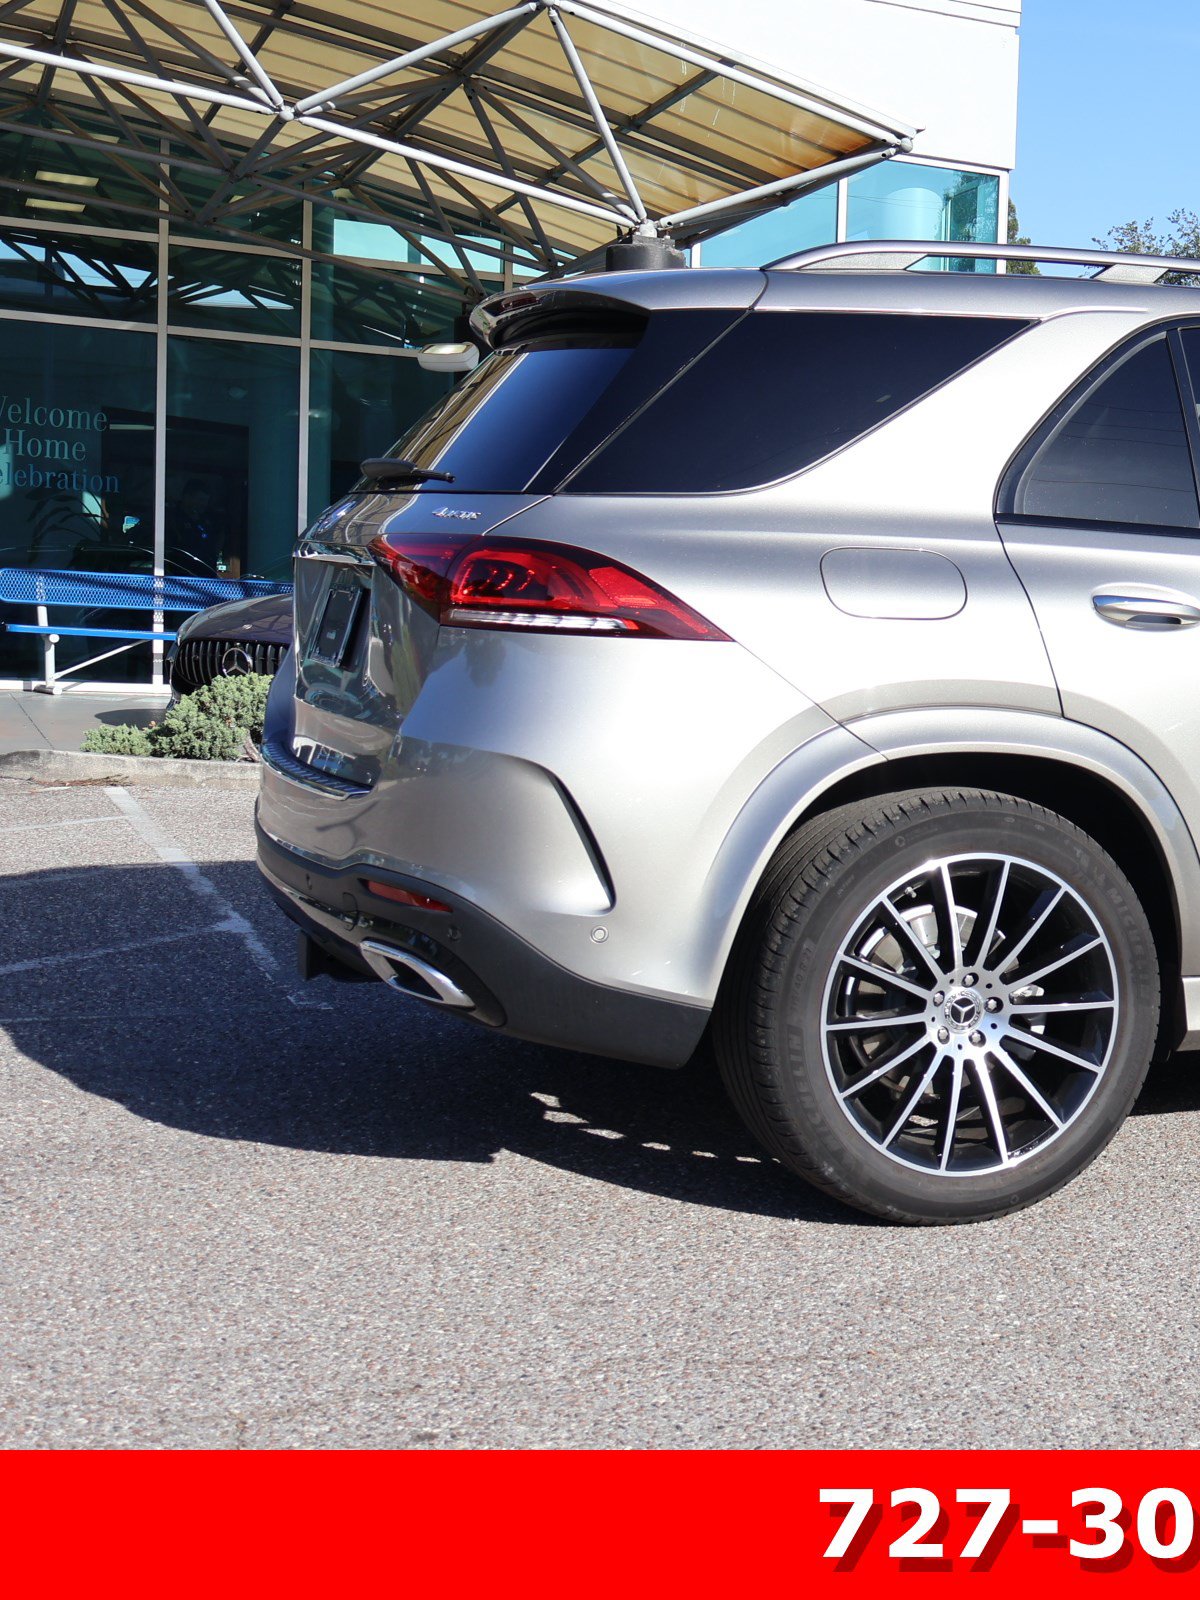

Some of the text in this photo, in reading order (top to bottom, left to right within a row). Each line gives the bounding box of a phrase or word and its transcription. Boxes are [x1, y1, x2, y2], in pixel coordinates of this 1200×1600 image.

[4, 428, 86, 461] Home
[0, 462, 120, 493] lebration
[788, 1031, 842, 1153] MICHELIN
